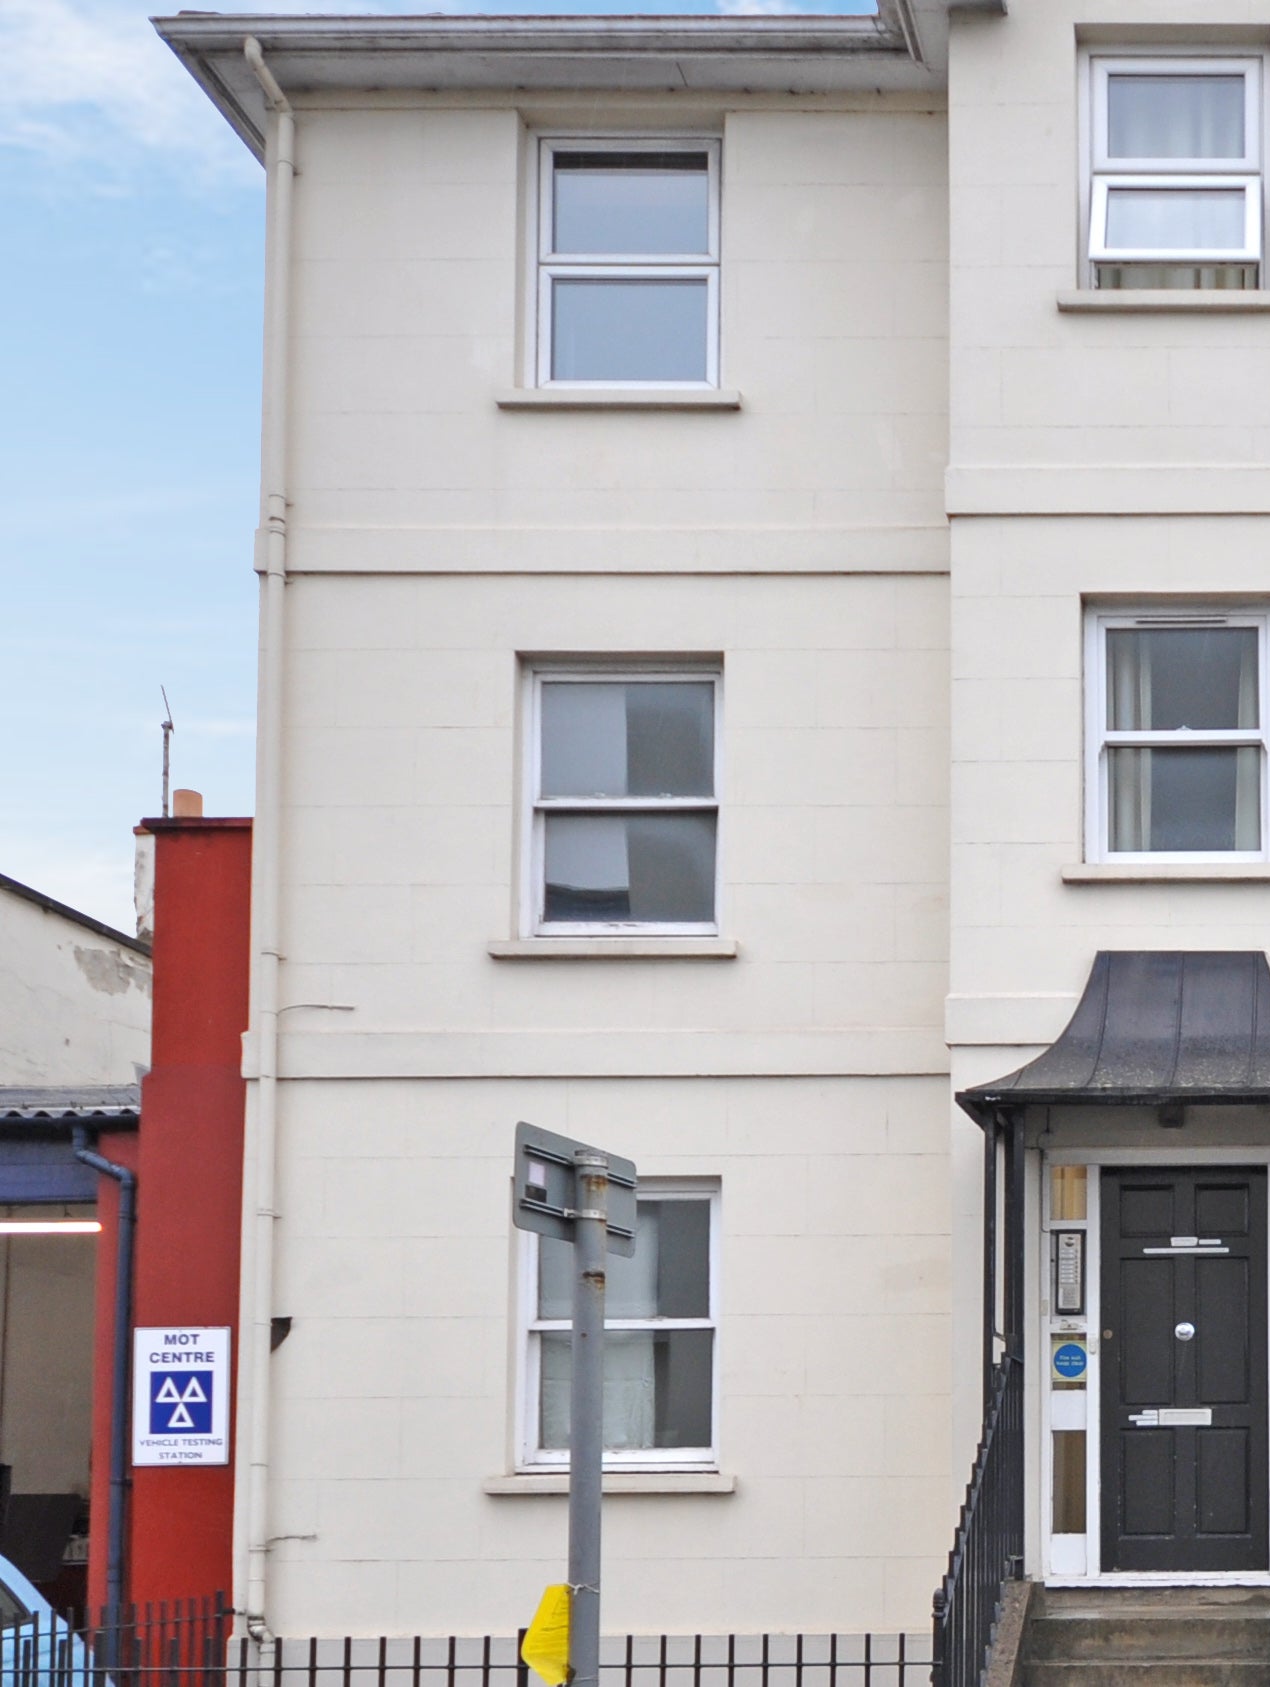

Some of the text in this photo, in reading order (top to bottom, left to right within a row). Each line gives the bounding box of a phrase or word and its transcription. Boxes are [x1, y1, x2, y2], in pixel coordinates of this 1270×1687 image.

[164, 1333, 200, 1346] MOT
[149, 1351, 215, 1364] CENTRE
[139, 1438, 223, 1447] VEHICLE TESTING
[158, 1451, 203, 1460] STATION
